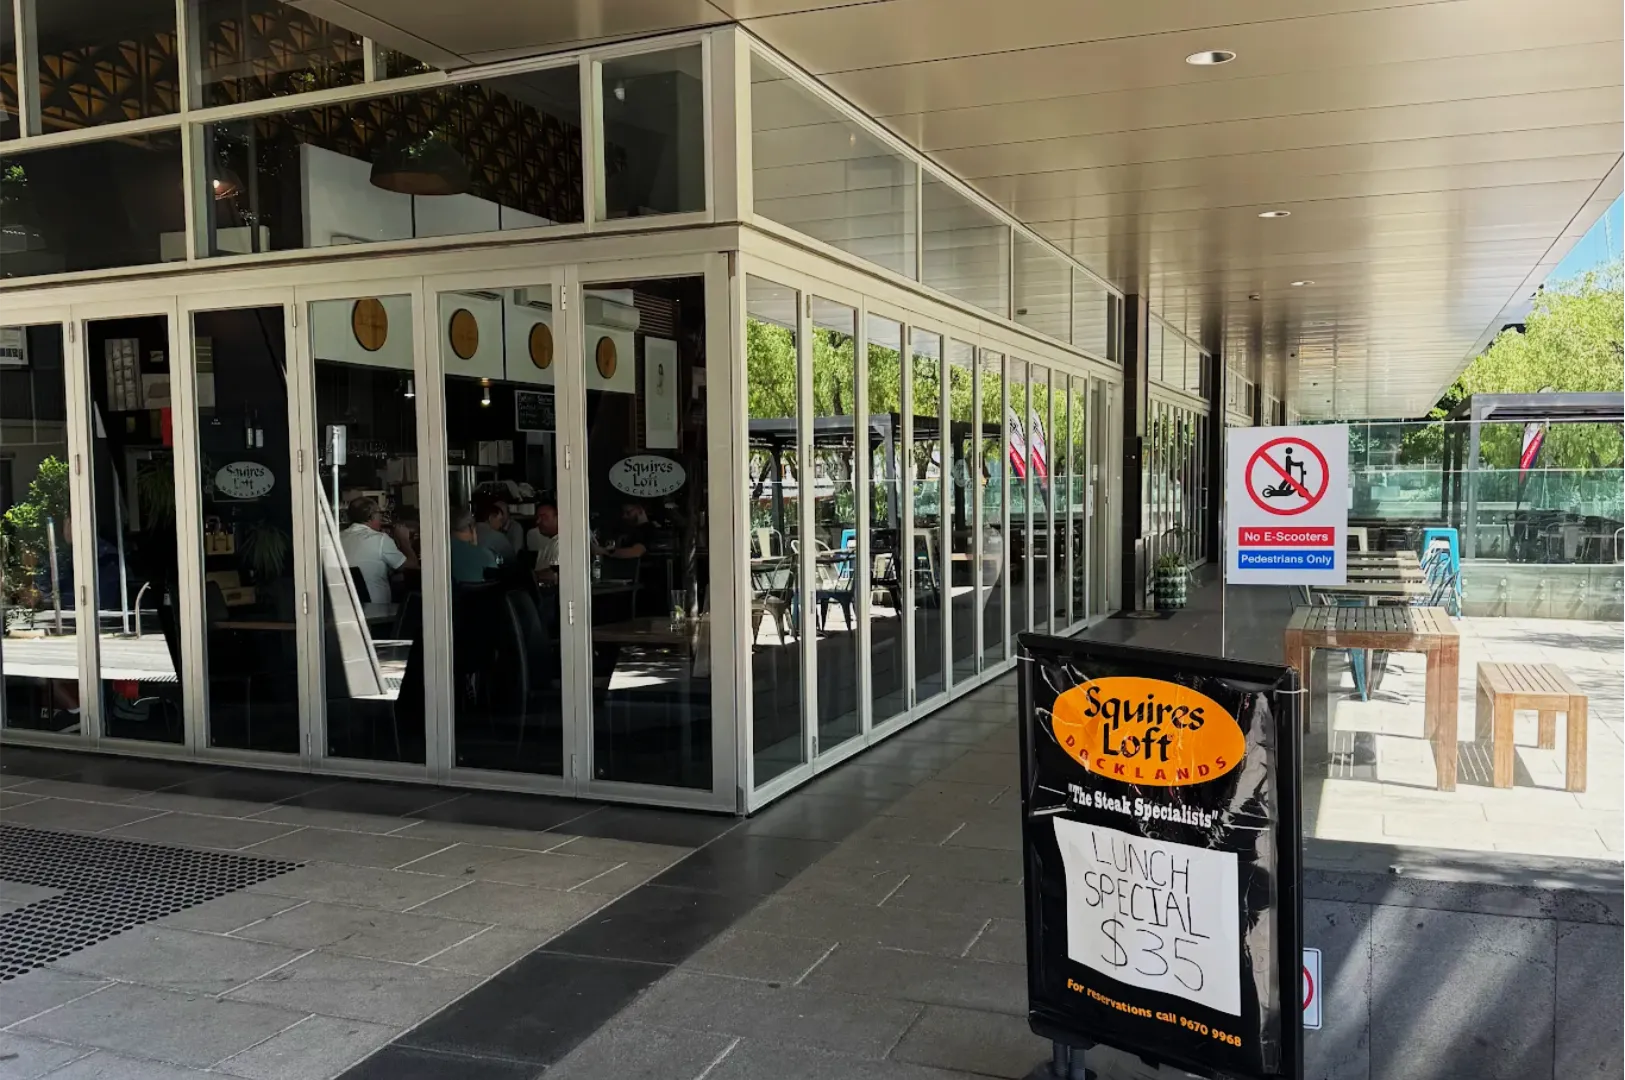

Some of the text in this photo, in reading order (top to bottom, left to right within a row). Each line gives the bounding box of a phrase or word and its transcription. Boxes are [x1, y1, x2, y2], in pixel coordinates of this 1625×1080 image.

[233, 477, 254, 490] Lft
[624, 459, 673, 476] Squires
[633, 472, 658, 487] Loft
[1244, 531, 1329, 541] No E-Scooters
[1241, 554, 1332, 565] Pedestrians Only
[1084, 686, 1205, 731] Squires
[1065, 734, 1227, 780] DOCKLANDS
[1103, 722, 1173, 762] Loft
[1094, 790, 1132, 815] Steak
[1091, 831, 1190, 894] LUNCH
[1084, 871, 1211, 939] SPECIAL
[1101, 912, 1204, 992] $35
[1067, 978, 1242, 1048] For reservations call 9670 9968
